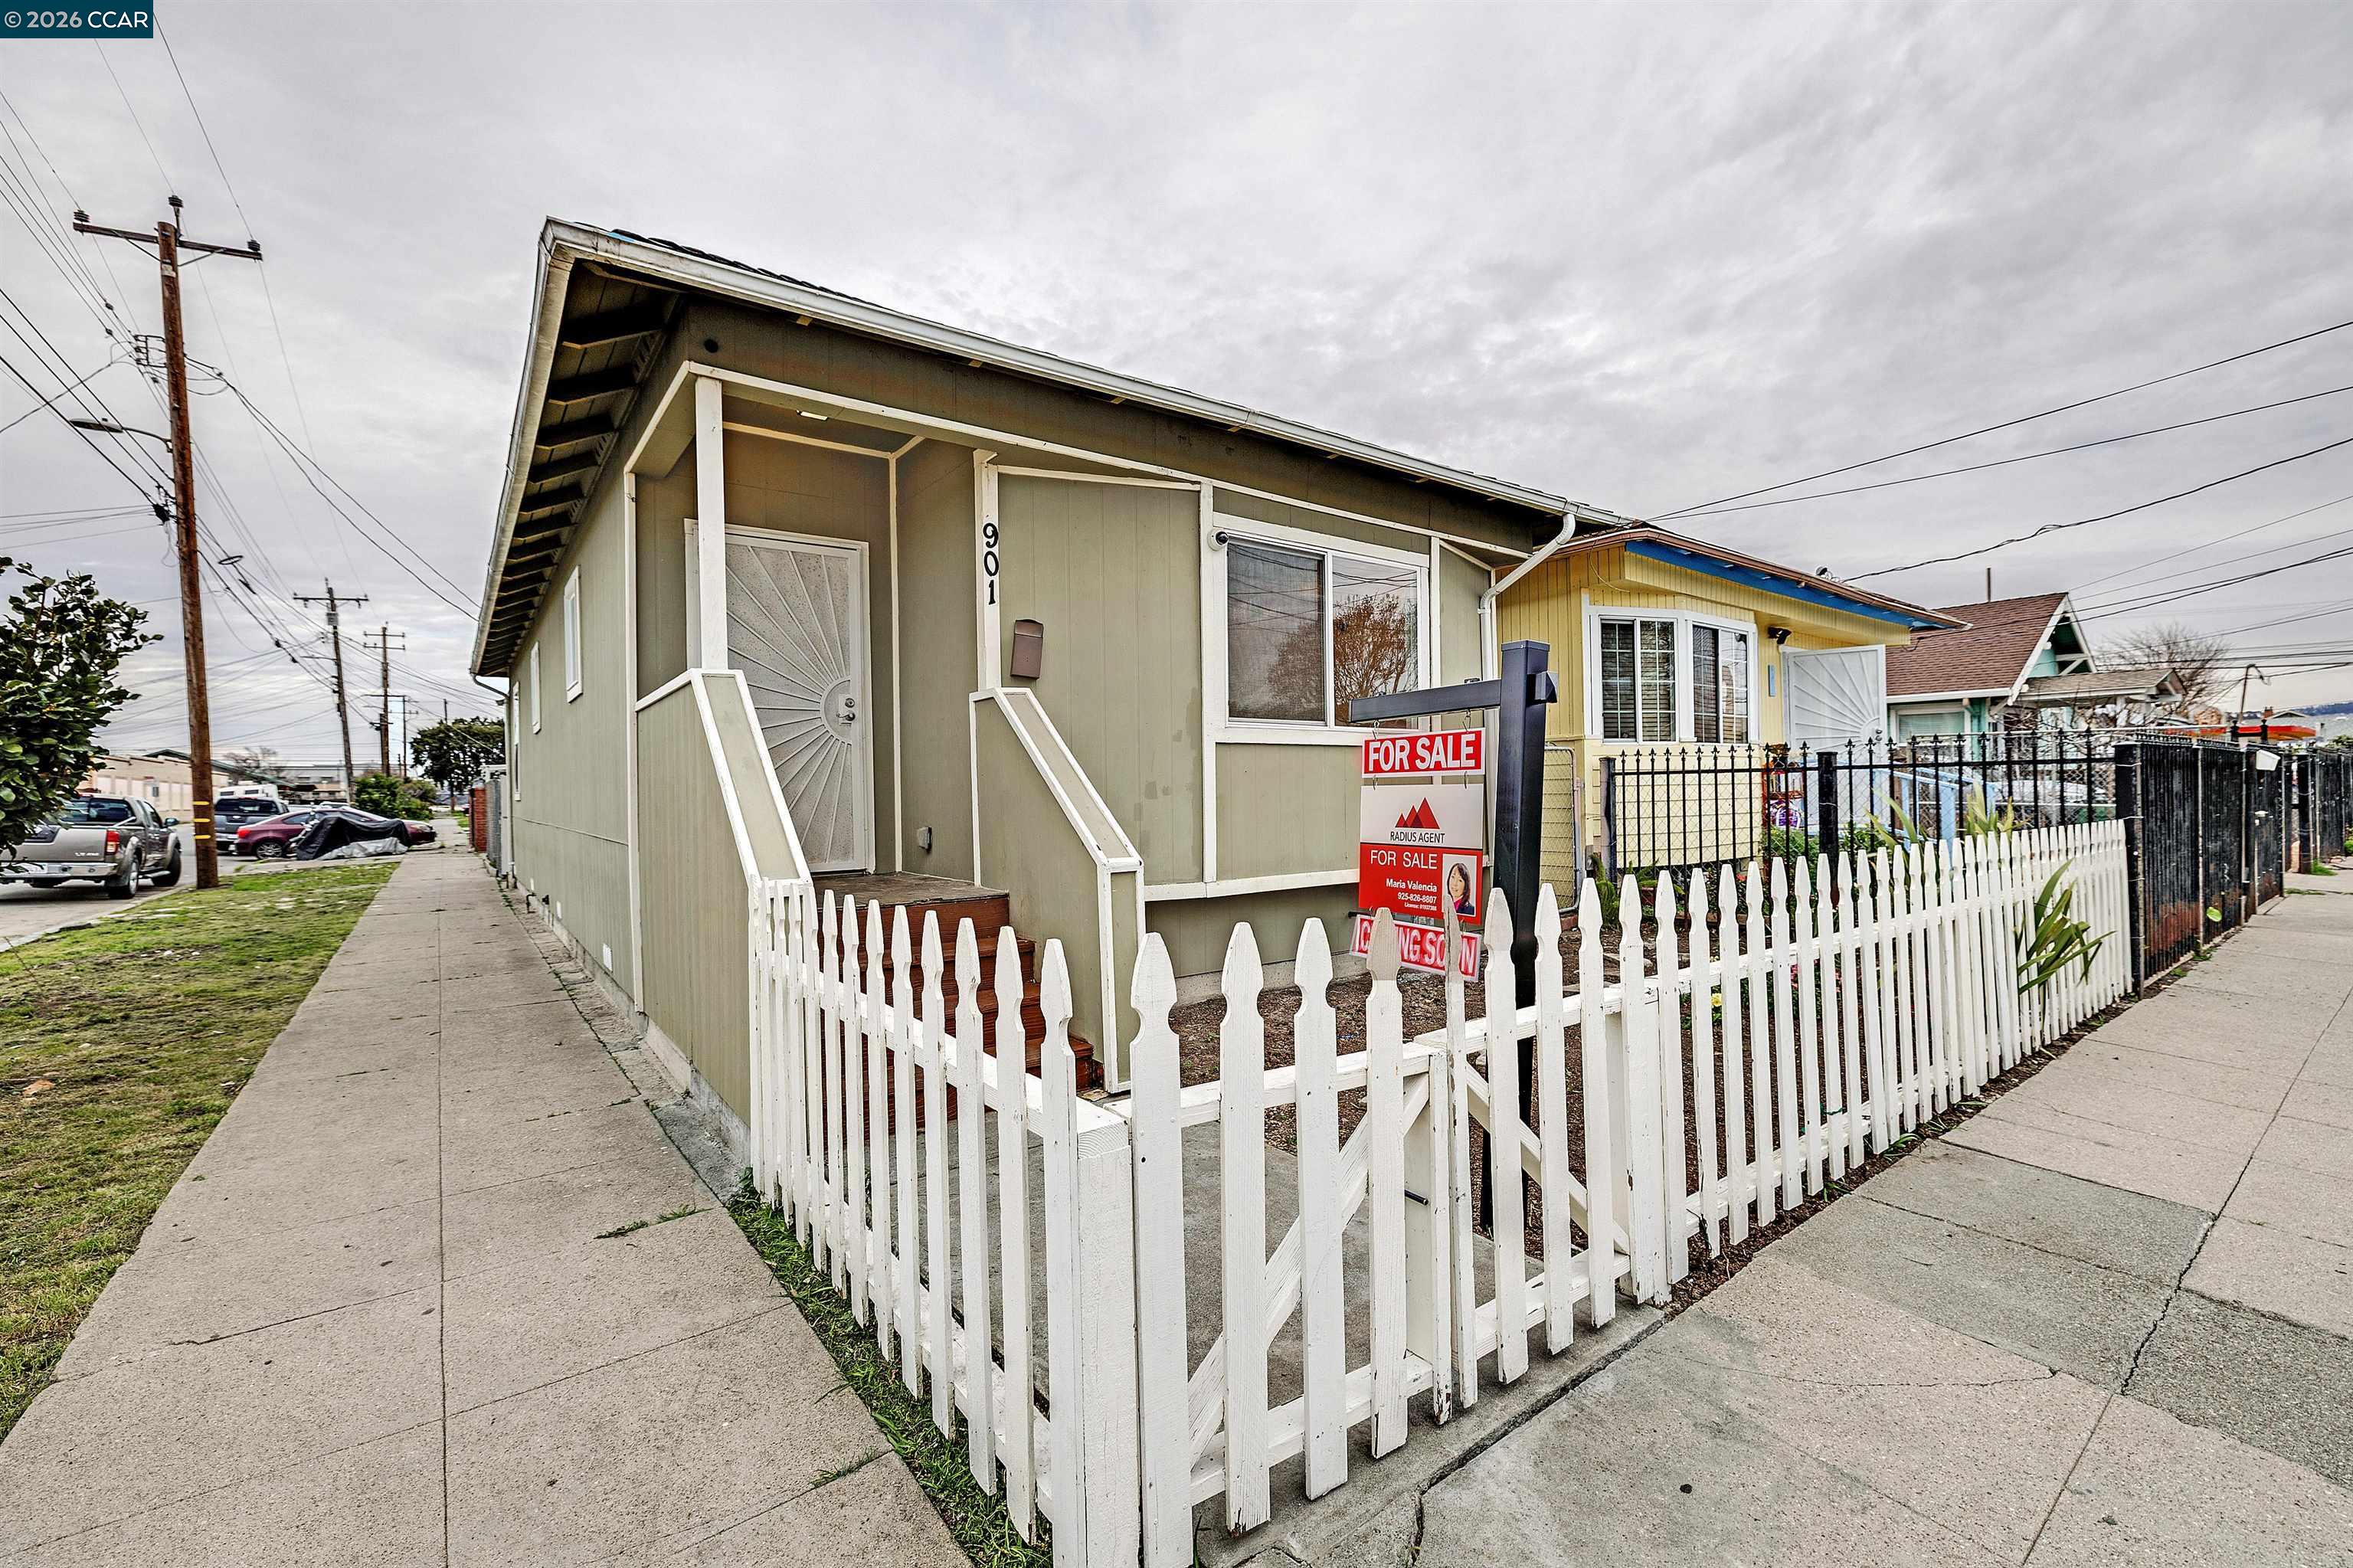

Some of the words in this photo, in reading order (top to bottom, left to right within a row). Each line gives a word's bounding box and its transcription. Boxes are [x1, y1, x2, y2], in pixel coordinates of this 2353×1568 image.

[983, 522, 1000, 605] 901
[1369, 739, 1409, 771] FOR
[1415, 734, 1475, 769] SALE
[1390, 830, 1417, 842] RADIUS
[1418, 833, 1445, 843] AGENT
[1370, 849, 1396, 866] FOR
[1402, 851, 1438, 869] SALE
[1386, 878, 1406, 889] Maria
[1407, 880, 1437, 892] Valencia
